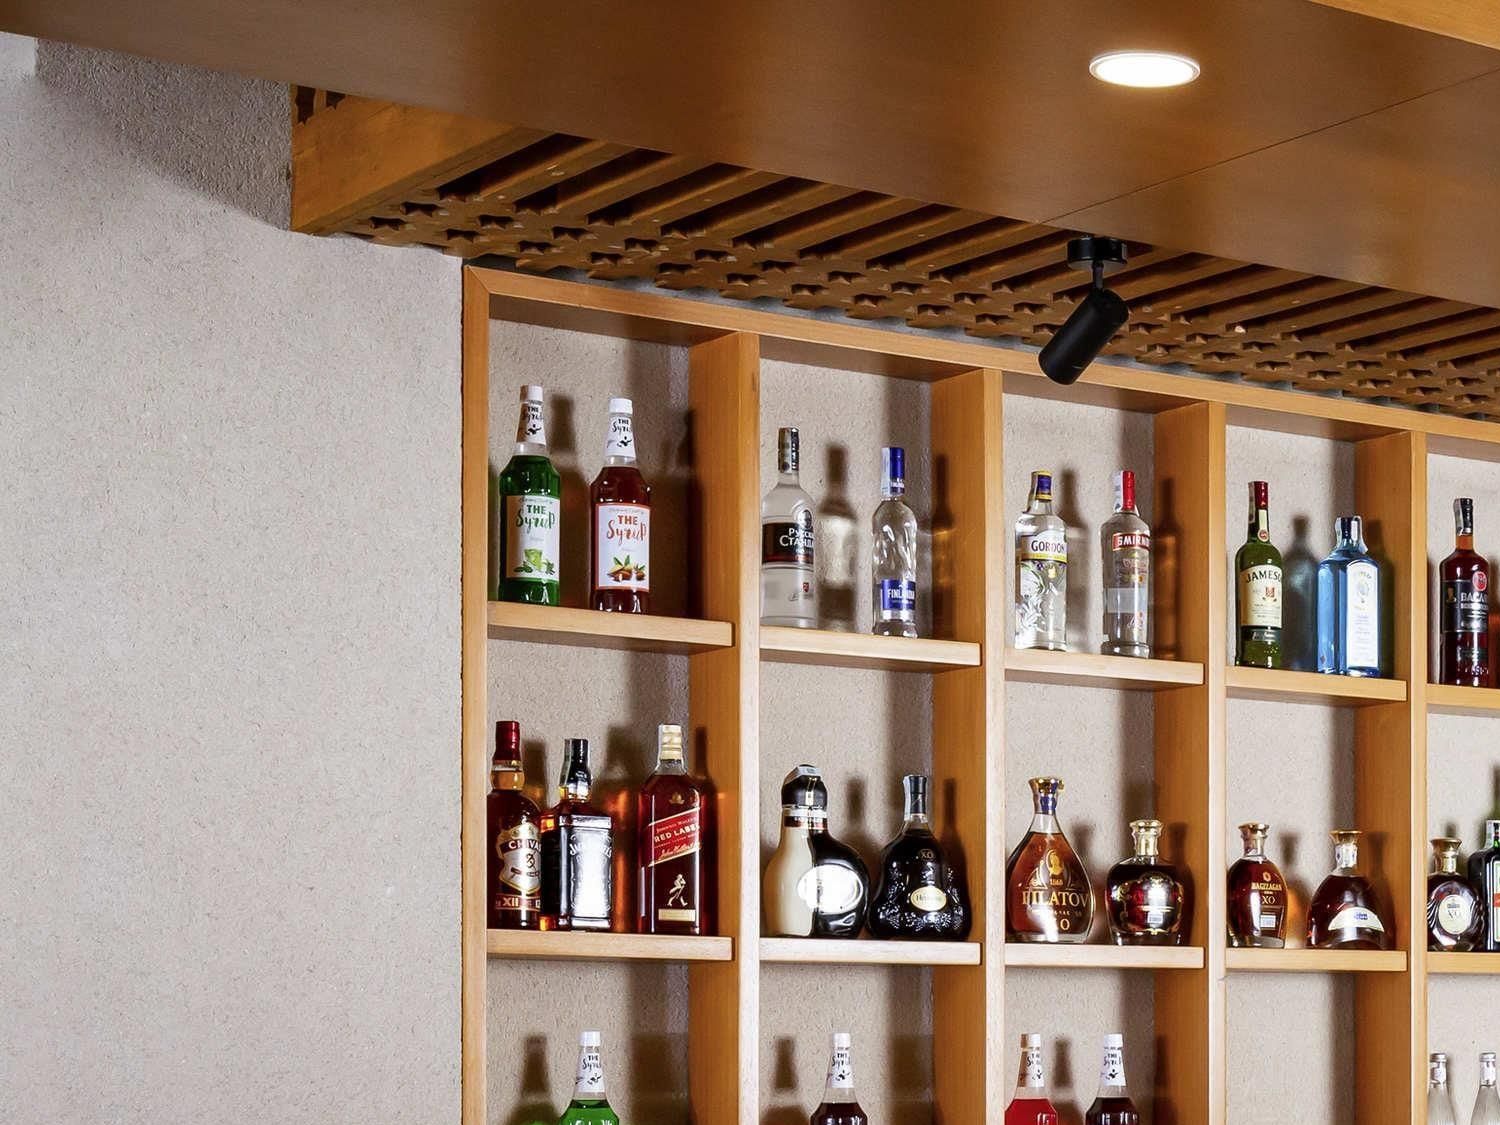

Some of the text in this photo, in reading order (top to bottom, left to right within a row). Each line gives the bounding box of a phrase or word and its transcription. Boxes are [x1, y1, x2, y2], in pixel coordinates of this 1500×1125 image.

[527, 504, 547, 514] THE
[617, 515, 638, 525] THE
[653, 831, 673, 844] RED
[1261, 895, 1276, 905] XO
